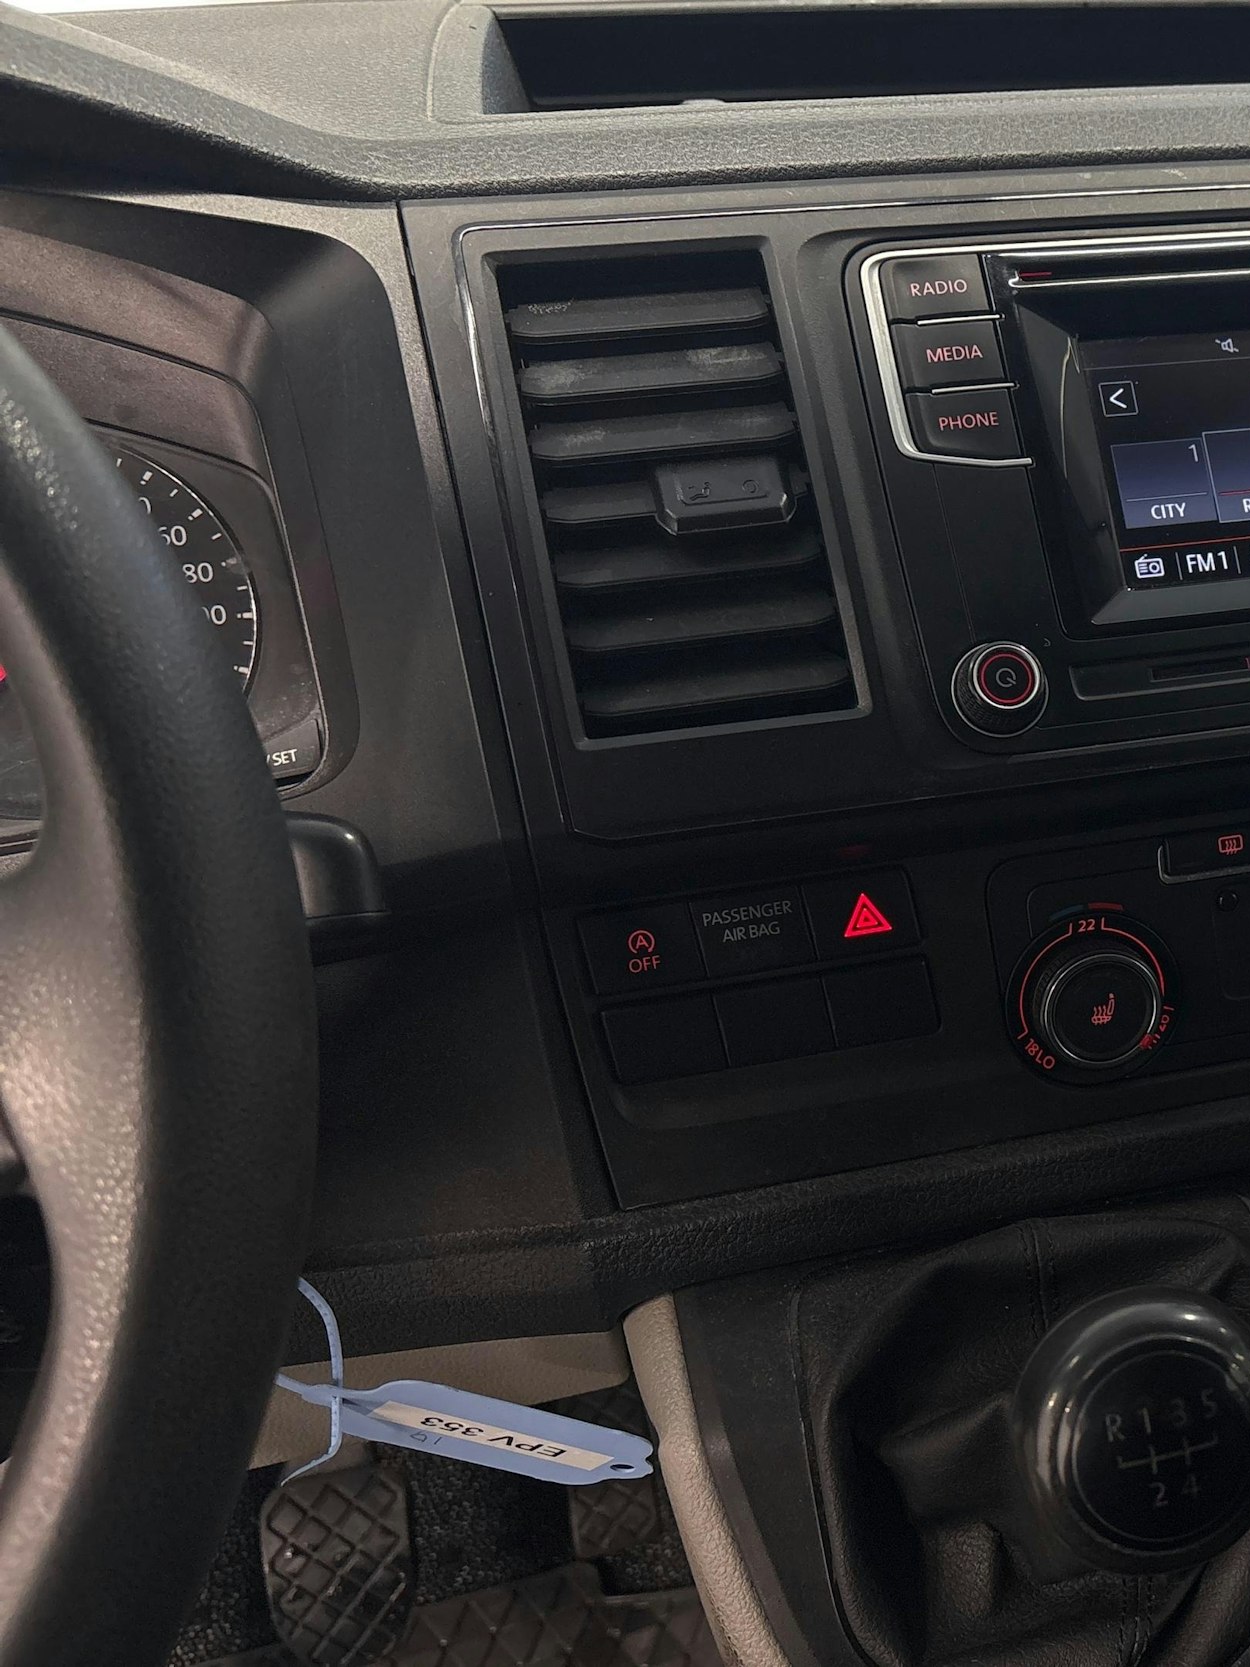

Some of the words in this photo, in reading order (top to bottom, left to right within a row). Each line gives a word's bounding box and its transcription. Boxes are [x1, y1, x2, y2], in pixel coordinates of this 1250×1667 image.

[910, 279, 967, 297] RADIO
[926, 344, 983, 363] MEDIA
[938, 412, 999, 431] PHONE
[1188, 444, 1198, 463] 1
[1151, 503, 1185, 519] CITY
[702, 900, 793, 926] PASSENGER
[1077, 919, 1096, 933] 22
[628, 955, 661, 974] OFF
[420, 1417, 485, 1437] 353
[1105, 1413, 1126, 1442] R
[1138, 1407, 1152, 1434] 1
[487, 1435, 567, 1458] EPV
[1149, 1481, 1169, 1507] 2
